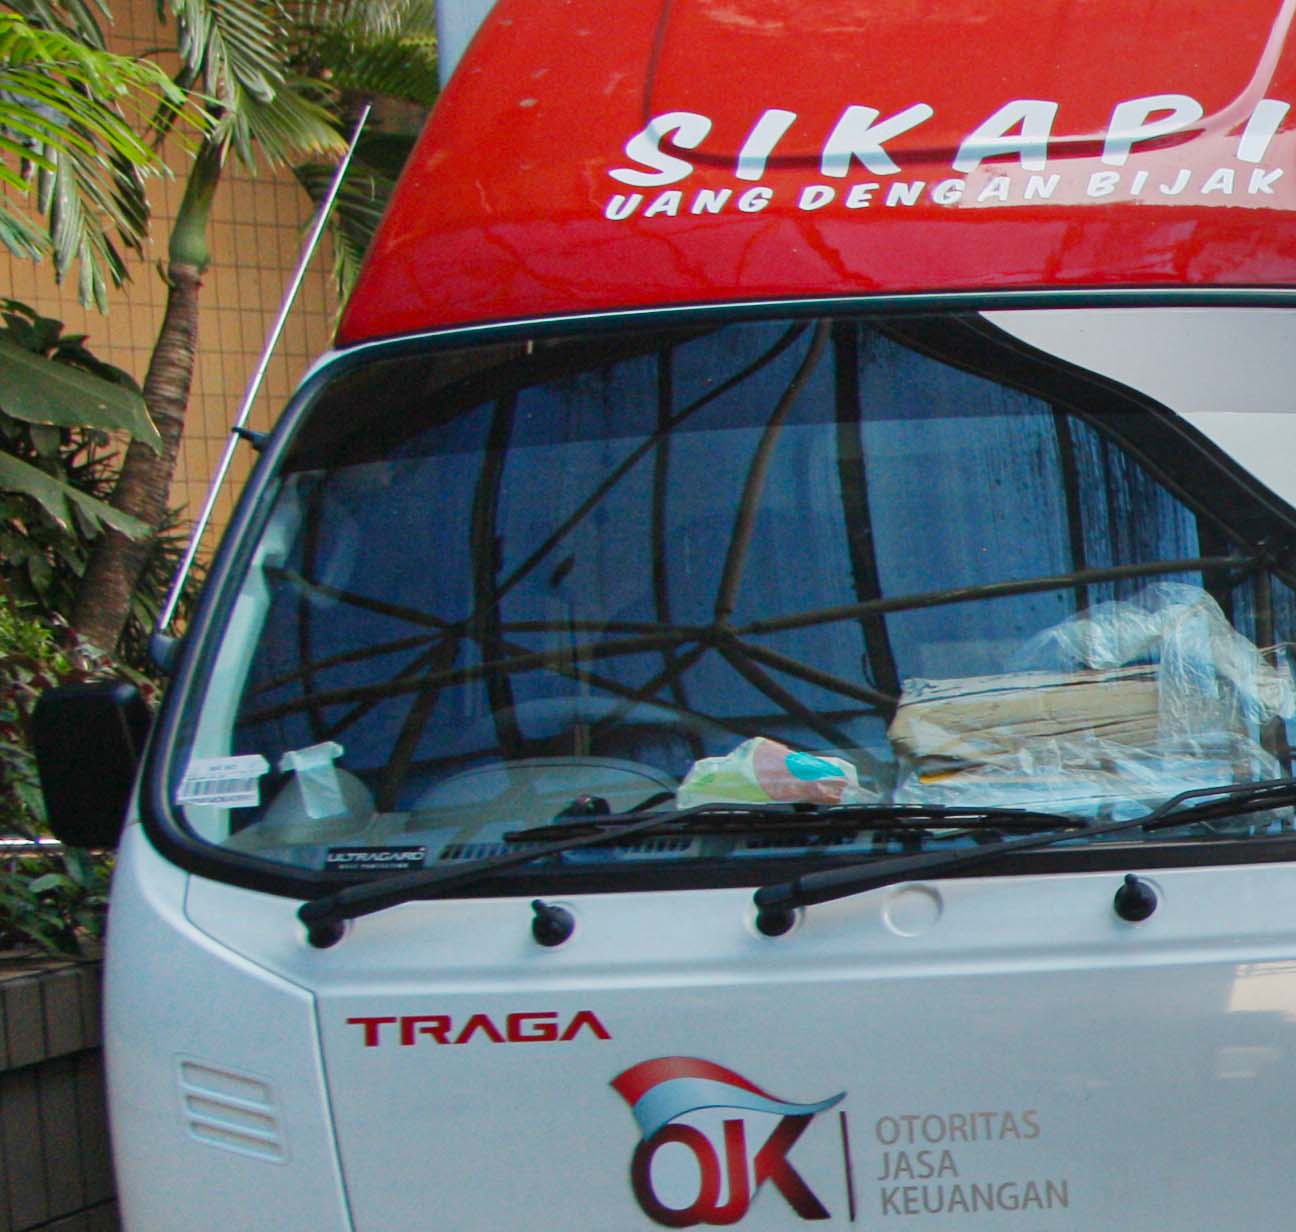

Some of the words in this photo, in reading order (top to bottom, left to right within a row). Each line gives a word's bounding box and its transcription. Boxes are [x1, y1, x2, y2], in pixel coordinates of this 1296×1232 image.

[608, 94, 1290, 187] SIKAPI
[605, 187, 772, 220] UANG
[799, 174, 1058, 211] DENGAN
[1087, 167, 1285, 197] BIJAK
[347, 1010, 612, 1047] TRAGA
[875, 1109, 1041, 1147] OTORITAS
[632, 1111, 831, 1228] OJK
[876, 1150, 958, 1181] JASA
[880, 1179, 1070, 1217] KEUANGAN
